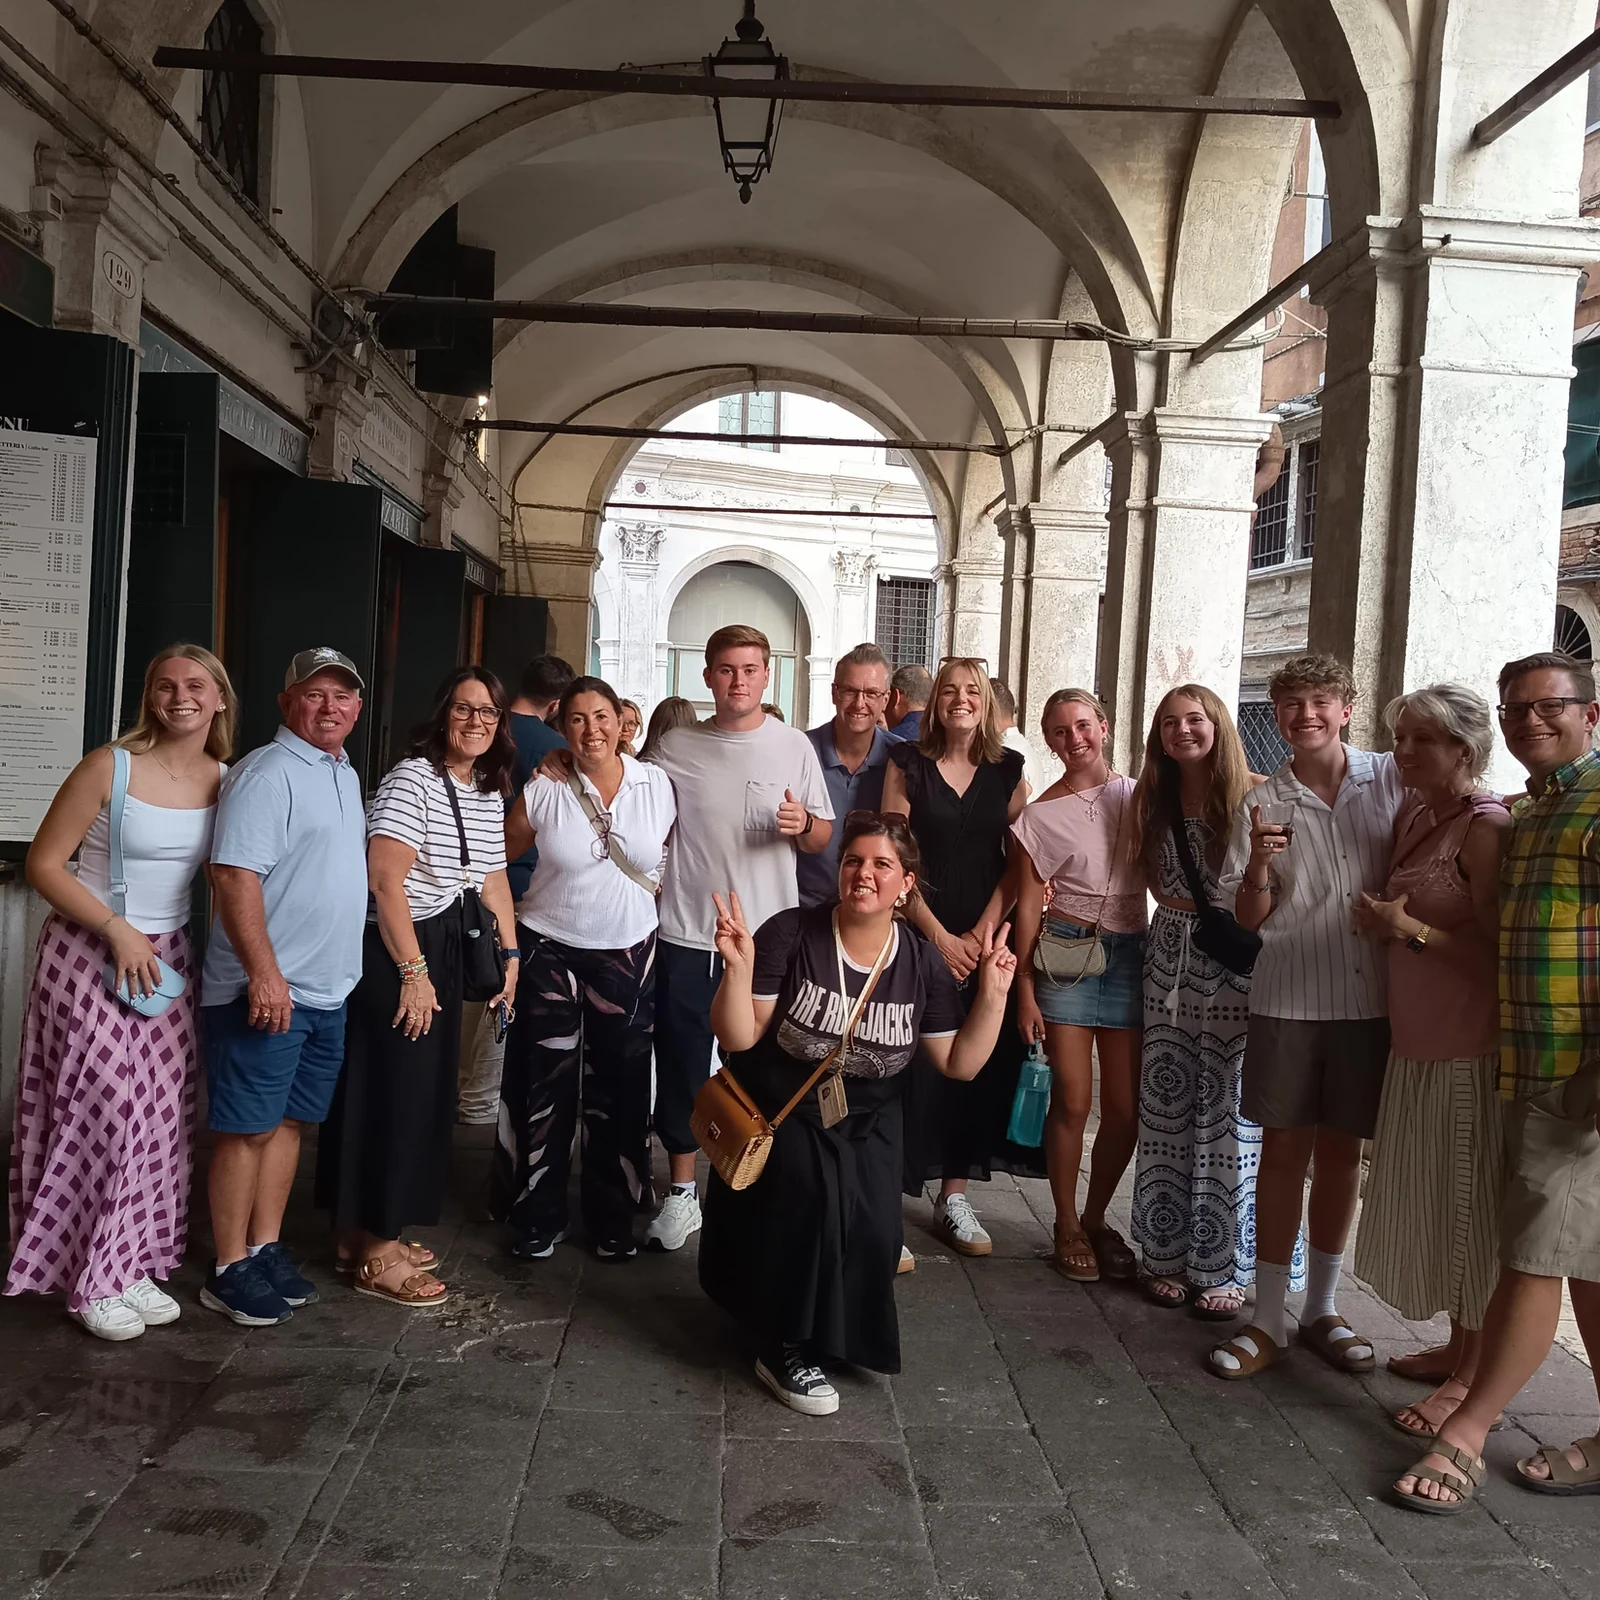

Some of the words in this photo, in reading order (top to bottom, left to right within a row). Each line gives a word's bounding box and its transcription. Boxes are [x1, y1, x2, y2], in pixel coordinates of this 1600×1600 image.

[108, 258, 132, 292] 129
[277, 427, 300, 465] 1882
[787, 978, 827, 1029] THE
